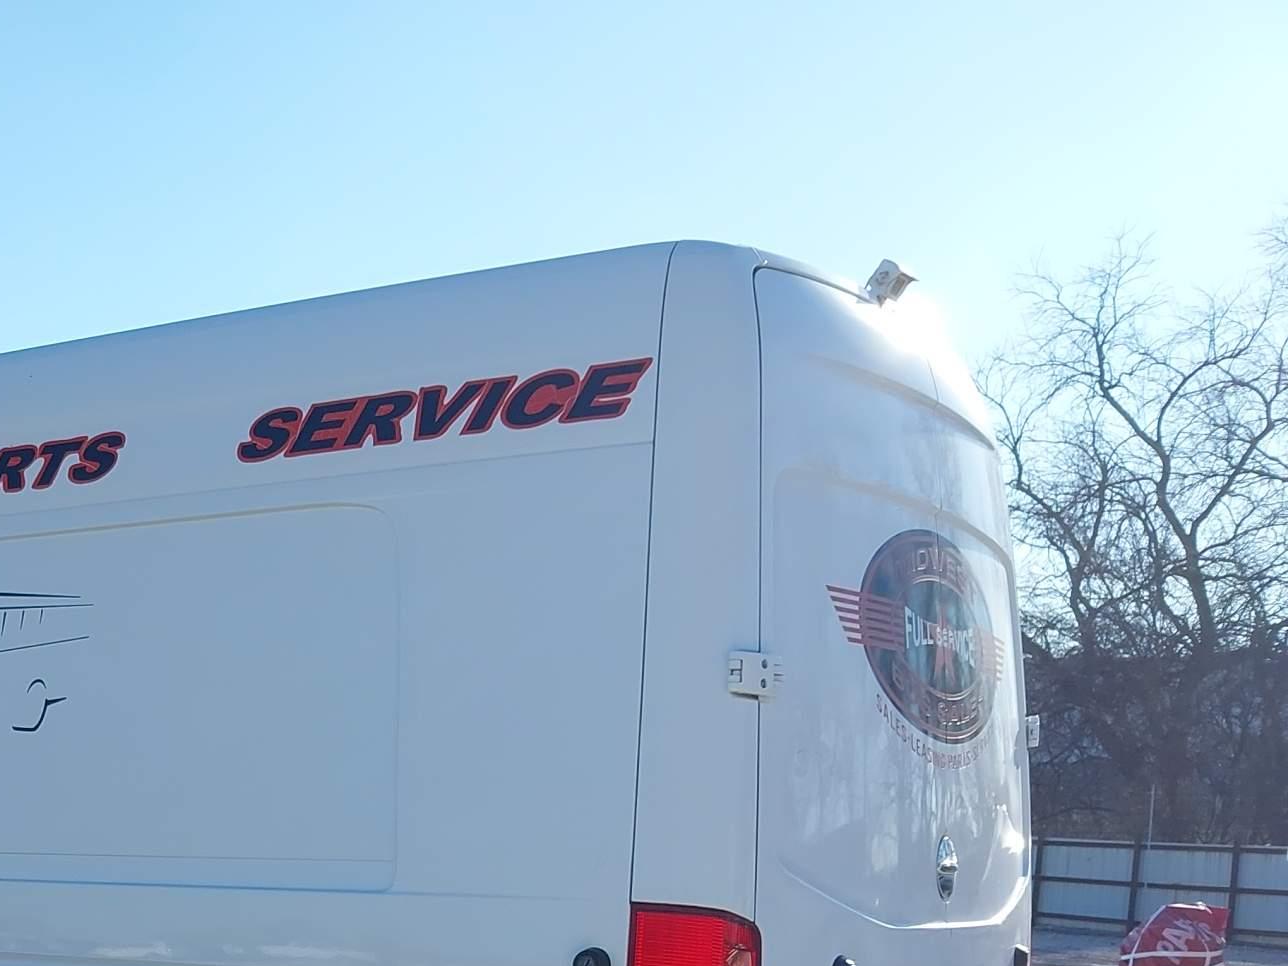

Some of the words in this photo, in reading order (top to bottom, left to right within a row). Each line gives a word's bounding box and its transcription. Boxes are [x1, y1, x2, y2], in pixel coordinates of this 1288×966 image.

[237, 357, 653, 463] SERVICE
[904, 606, 935, 649] FULL
[936, 626, 976, 669] SERVICE
